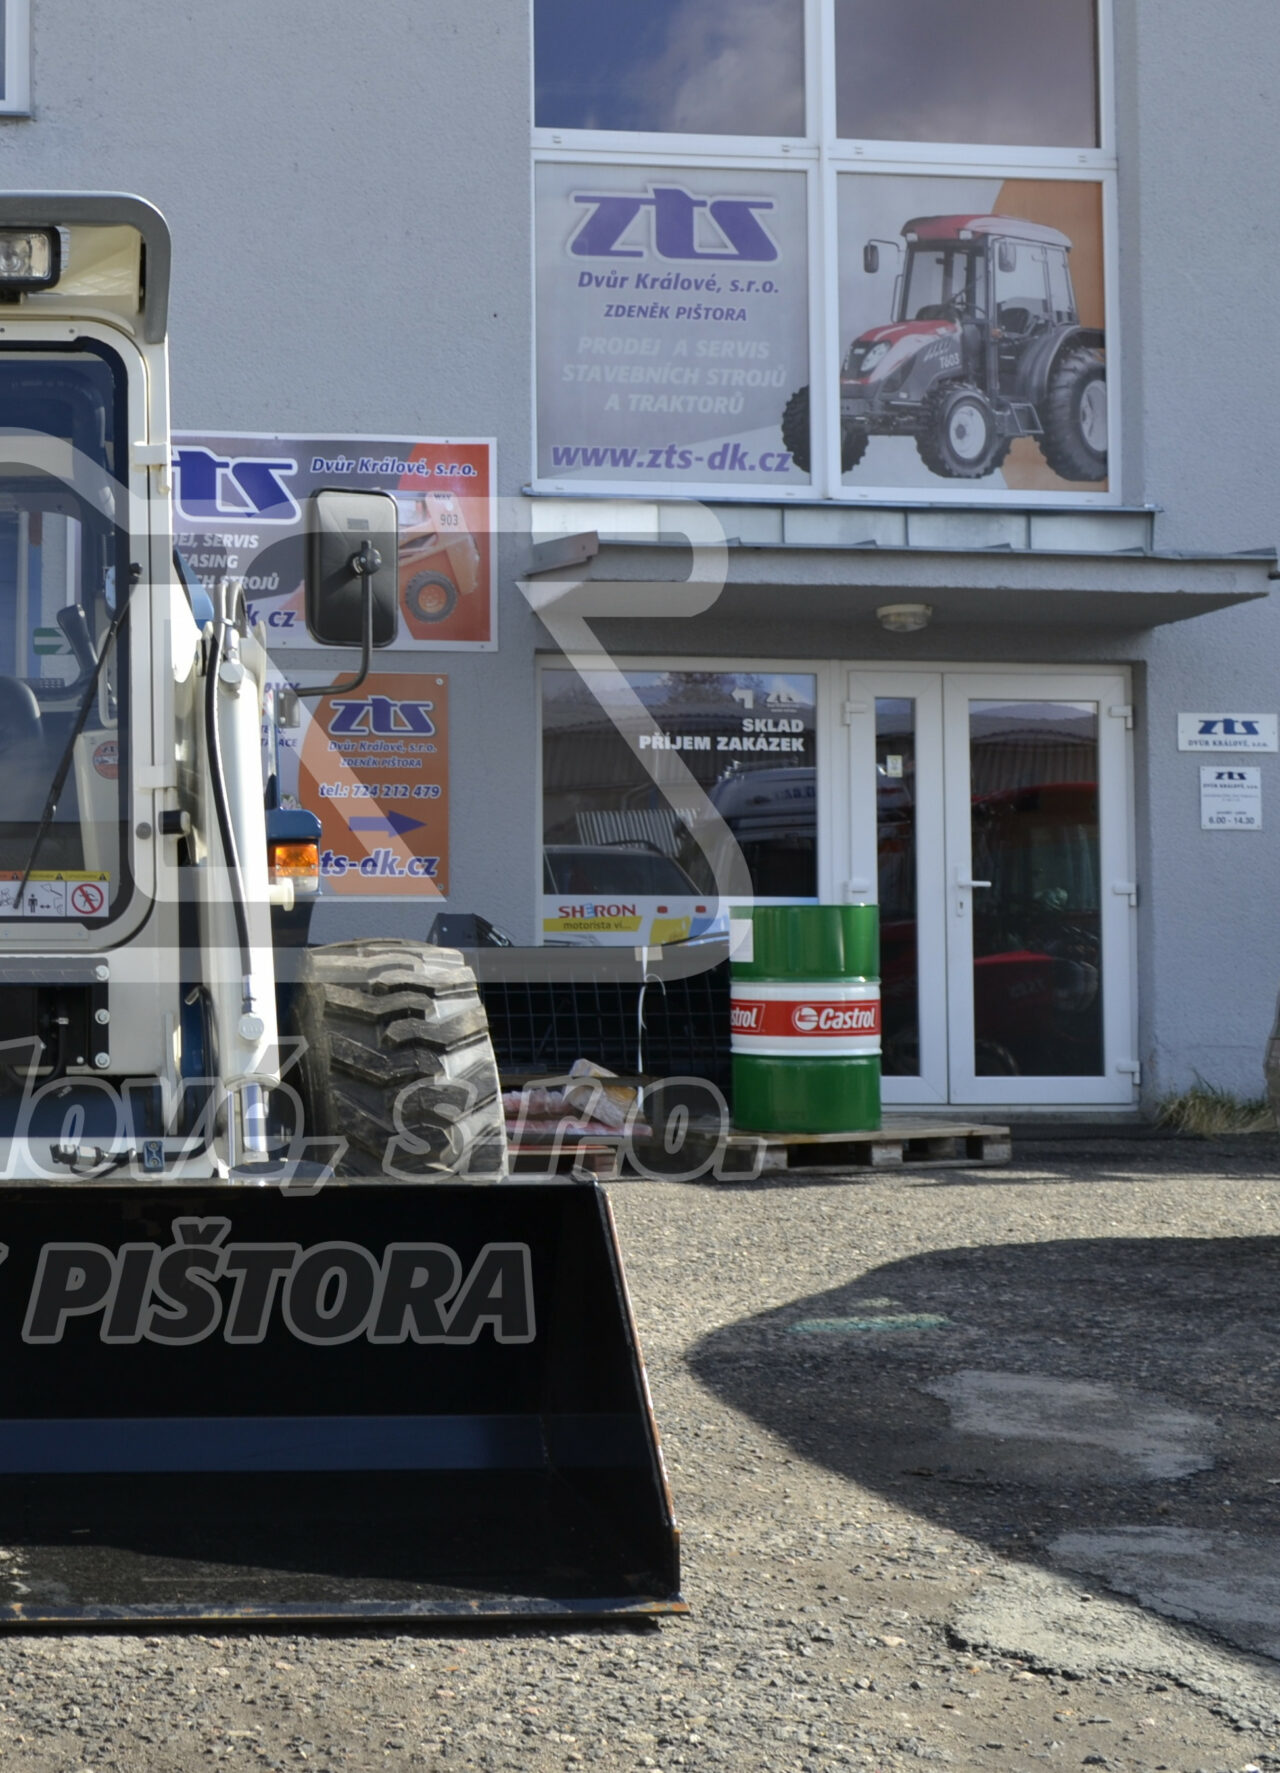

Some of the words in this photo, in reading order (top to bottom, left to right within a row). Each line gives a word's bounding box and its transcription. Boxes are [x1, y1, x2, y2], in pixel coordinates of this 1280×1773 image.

[578, 270, 629, 289] Dvůr
[634, 272, 722, 294] Králové,
[729, 279, 780, 294] s.r.o.
[604, 302, 670, 319] ZDENĚK
[675, 303, 747, 321] PIŠTORA
[577, 337, 662, 356] PRODEJ
[672, 339, 689, 357] A
[695, 340, 770, 359] SERVIS
[562, 362, 699, 385] STAVEBNÍCH
[706, 364, 788, 388] STROJŮ
[604, 394, 621, 411] A
[627, 391, 745, 415] TRAKTORŮ
[310, 454, 355, 474] Dvůr
[357, 456, 431, 477] Králové,
[434, 463, 478, 477] s.r.o.
[551, 442, 794, 473] www.zts-dk.cz
[170, 446, 302, 524] ts
[440, 513, 458, 526] 903
[203, 533, 260, 548] SERVIS
[180, 553, 239, 569] EASING
[742, 718, 805, 733] SKLAD
[328, 740, 356, 752] Dvůr
[359, 740, 406, 753] Králové,
[408, 743, 437, 753] s.r.o.
[638, 732, 711, 750] PŘÍJEM
[716, 733, 806, 752] ZAKÁZEK
[340, 755, 379, 768] ZDENĚK
[381, 755, 423, 768] PIŠTORA
[319, 781, 349, 798] tel.:
[352, 783, 380, 798] 724
[381, 783, 410, 798] 212
[412, 784, 441, 798] 479
[320, 848, 439, 877] ts-dk.cz
[558, 902, 636, 920] SHERON
[563, 920, 611, 930] motorista
[819, 1007, 876, 1030] Castrol
